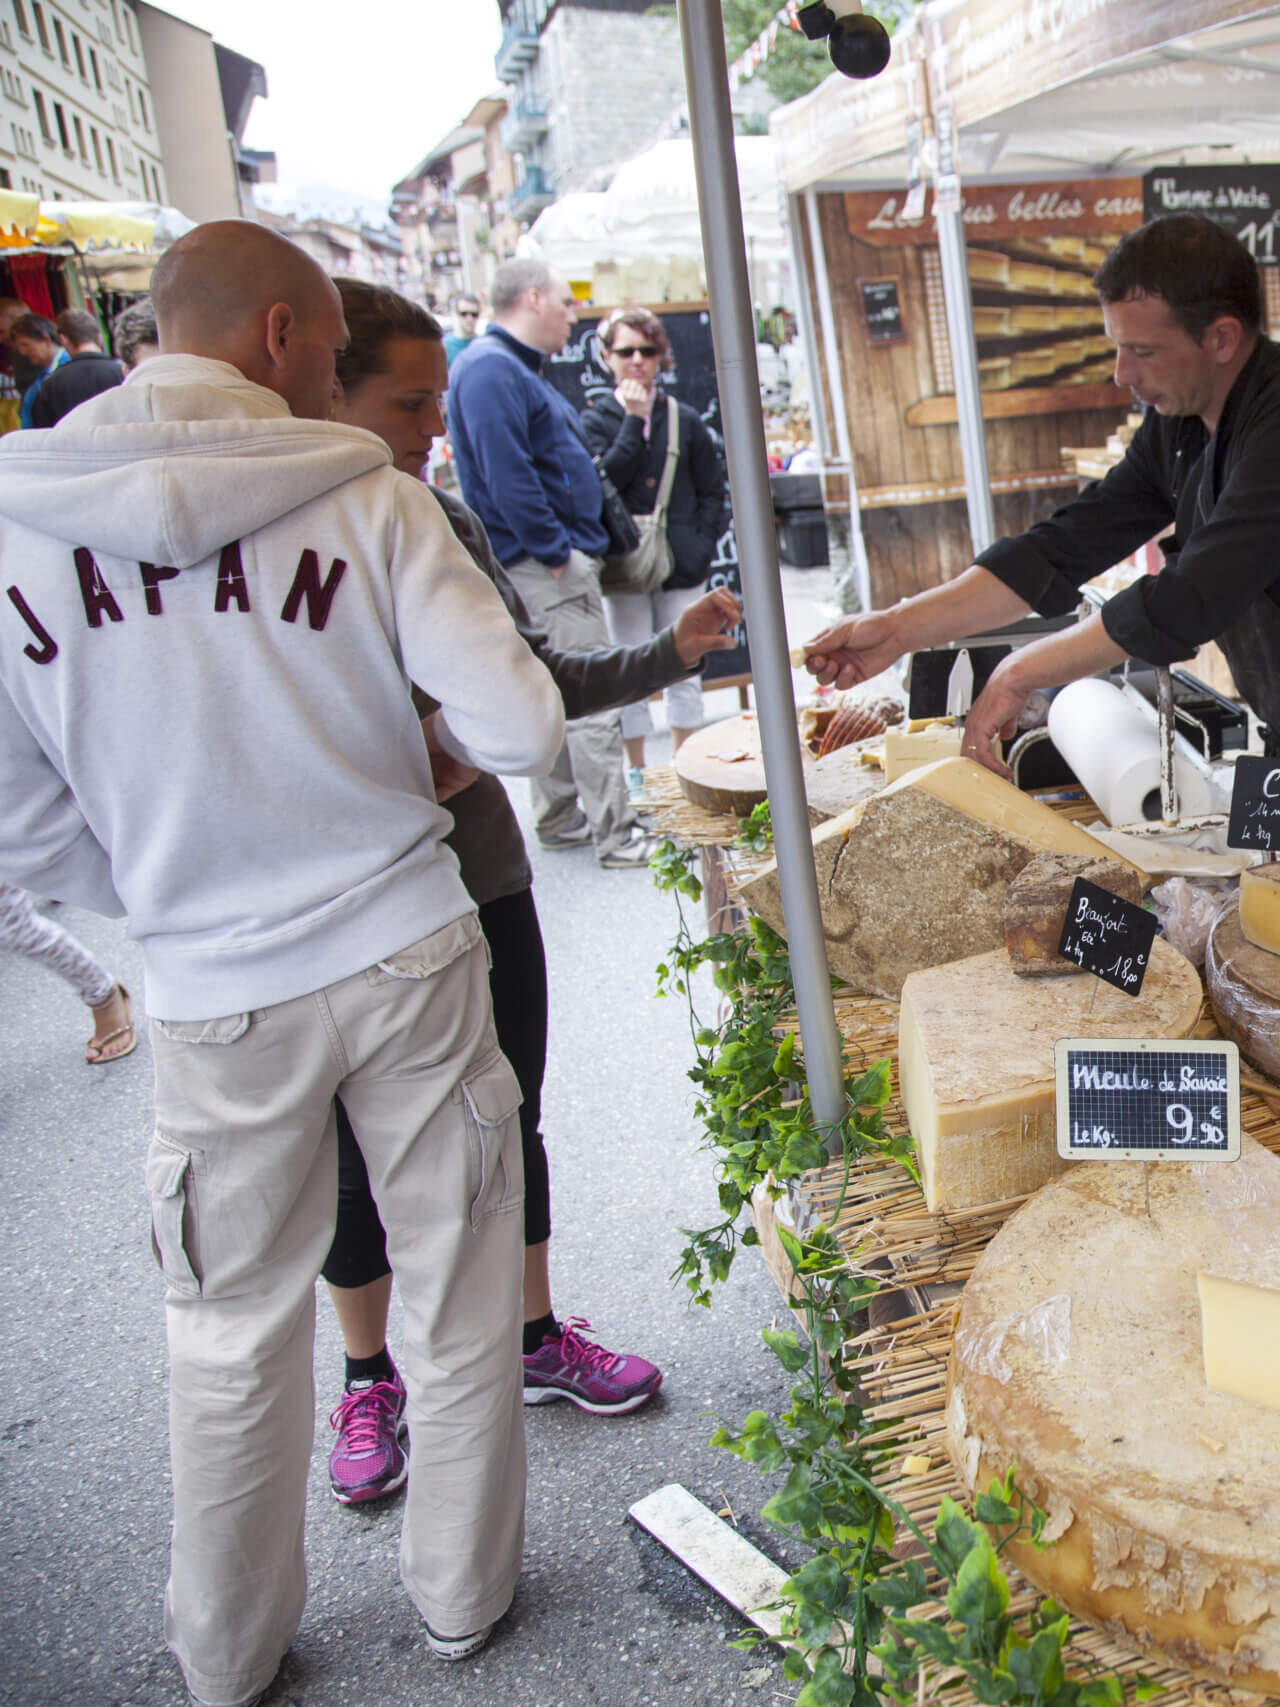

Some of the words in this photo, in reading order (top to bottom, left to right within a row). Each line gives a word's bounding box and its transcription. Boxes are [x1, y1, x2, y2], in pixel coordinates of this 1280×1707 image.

[1007, 191, 1084, 221] belles
[6, 538, 347, 665] JAPAN
[1158, 1069, 1176, 1092] de
[1178, 1065, 1231, 1093] Savoie
[1074, 1120, 1091, 1144] Le
